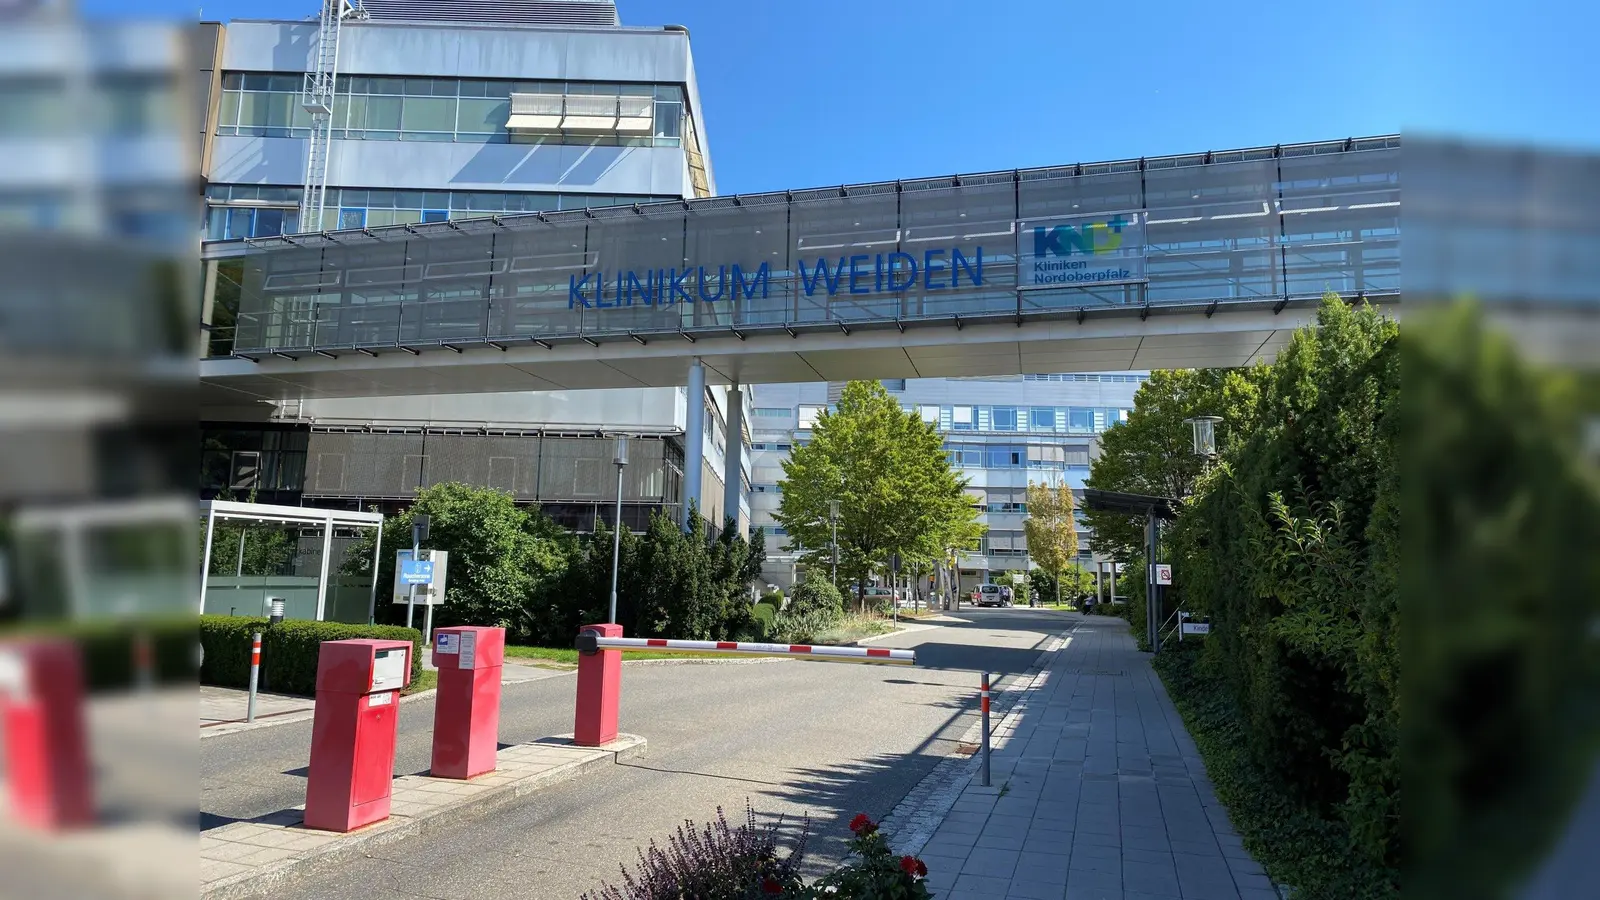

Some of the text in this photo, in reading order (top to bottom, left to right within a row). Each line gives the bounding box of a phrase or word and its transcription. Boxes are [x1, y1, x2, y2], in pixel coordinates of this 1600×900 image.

[1034, 260, 1087, 272] Kliniken
[568, 246, 983, 309] KLINIKUM WEIDEN
[1034, 268, 1131, 285] Nordoberpfalz
